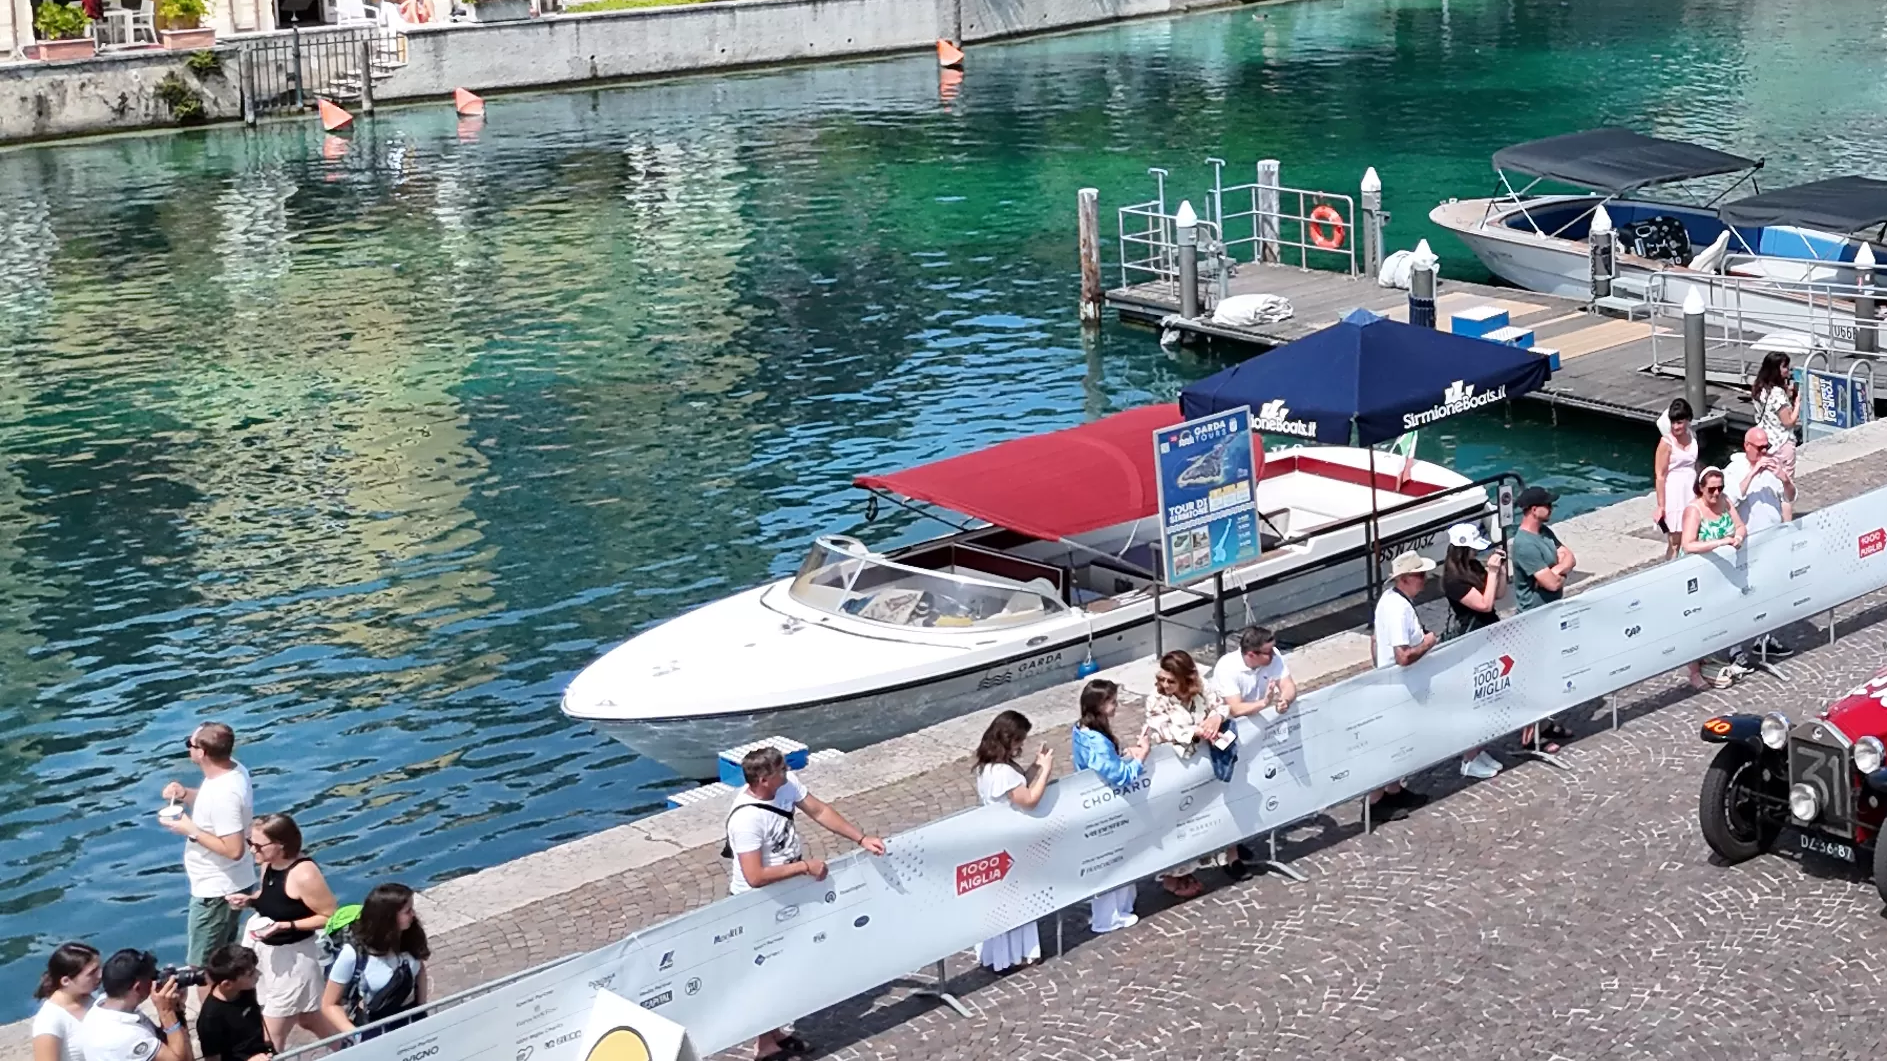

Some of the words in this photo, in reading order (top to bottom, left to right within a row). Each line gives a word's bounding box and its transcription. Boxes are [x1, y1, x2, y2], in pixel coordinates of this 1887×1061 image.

[1194, 420, 1226, 436] GARDA
[1168, 501, 1194, 516] TOUR
[1195, 497, 1208, 508] DI
[1018, 653, 1062, 672] GARDA
[1473, 667, 1500, 688] 1000
[1473, 676, 1511, 701] MIGLIA
[1797, 746, 1842, 816] 31
[1083, 778, 1151, 810] CHOPARD
[961, 857, 1000, 877] 1000
[959, 869, 1002, 892] MIGLIA
